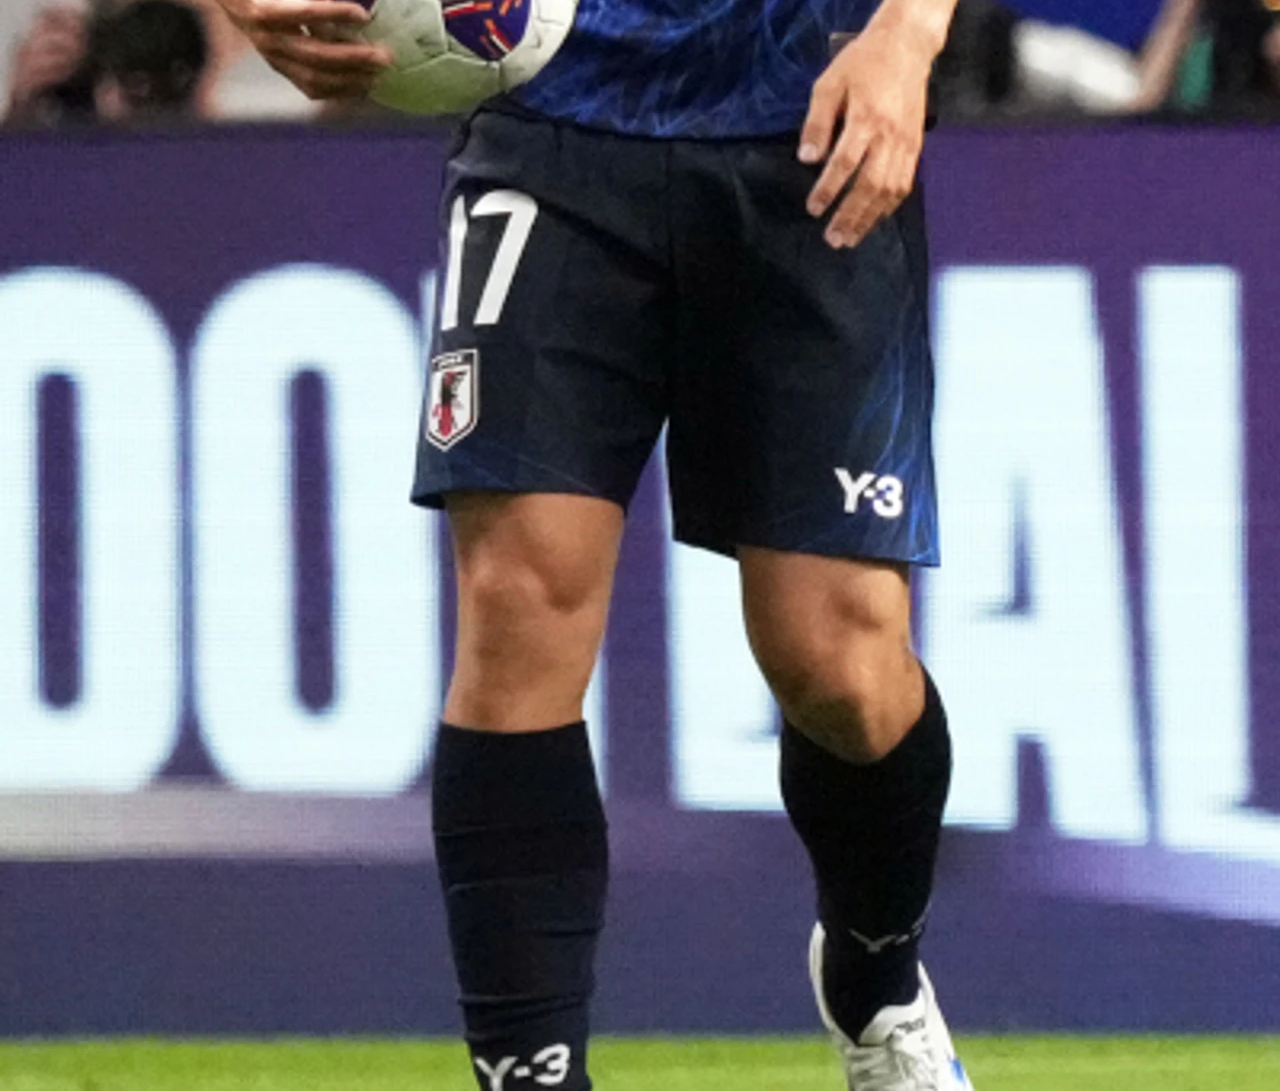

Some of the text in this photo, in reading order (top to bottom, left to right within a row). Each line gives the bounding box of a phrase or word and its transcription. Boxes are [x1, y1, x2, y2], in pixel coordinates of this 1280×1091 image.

[441, 189, 539, 332] 17
[834, 467, 903, 519] Y-3
[474, 1042, 572, 1091] Y-3
